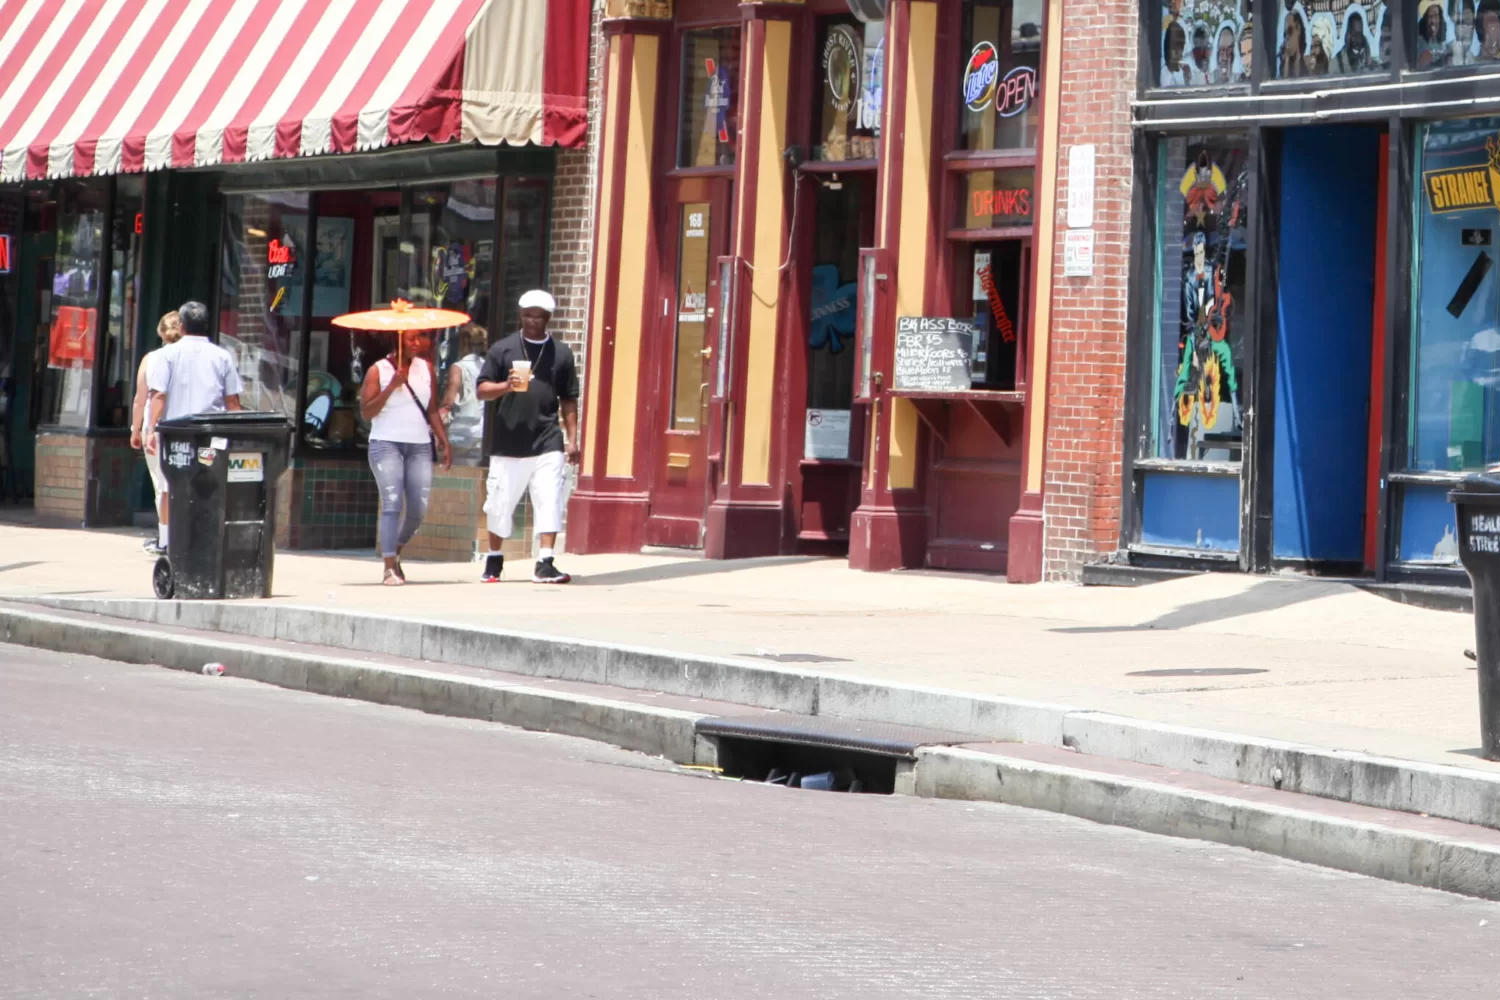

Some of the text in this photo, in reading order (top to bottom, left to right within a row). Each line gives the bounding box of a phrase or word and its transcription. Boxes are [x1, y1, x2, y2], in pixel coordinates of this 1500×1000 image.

[996, 70, 1036, 112] OPEN
[1431, 171, 1491, 208] STRANGE
[973, 189, 1031, 217] DRINKS
[689, 212, 702, 227] 168
[900, 317, 918, 333] BIG
[920, 317, 945, 330] ASS
[897, 334, 923, 348] PBR
[228, 459, 259, 470] WM
